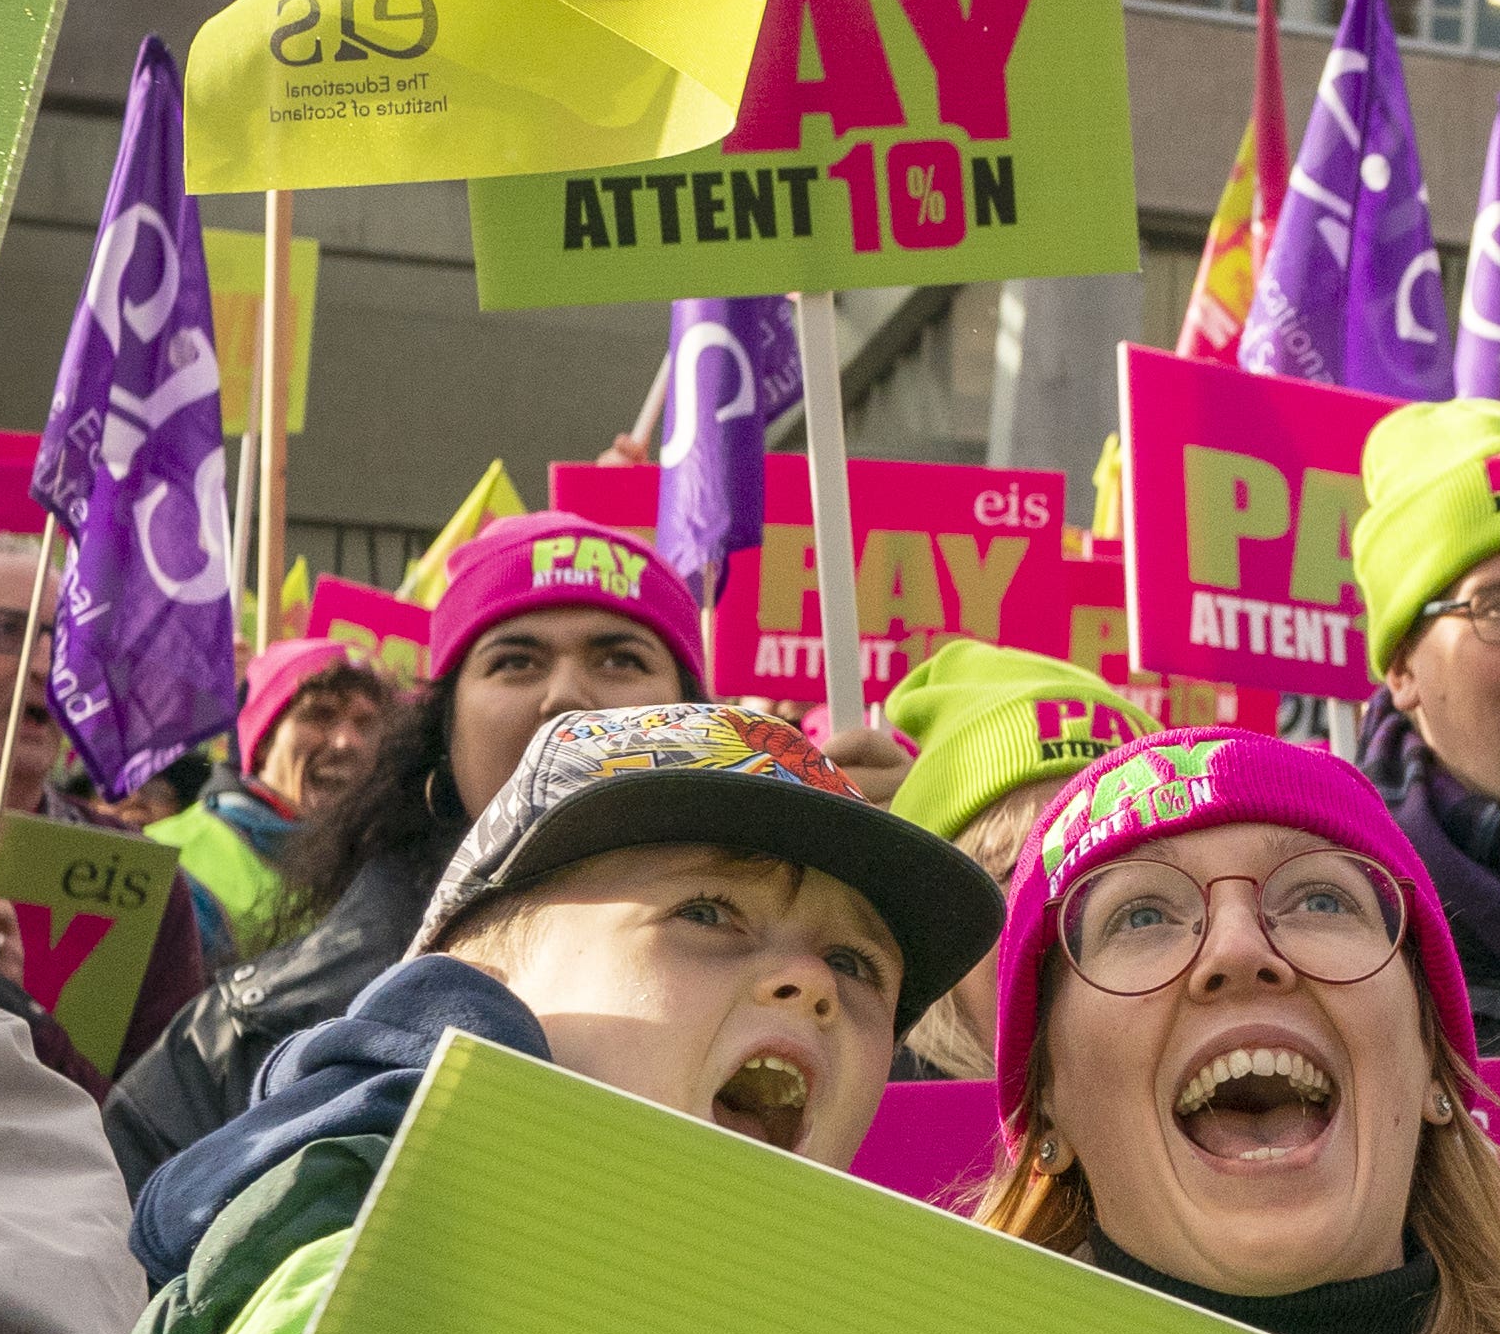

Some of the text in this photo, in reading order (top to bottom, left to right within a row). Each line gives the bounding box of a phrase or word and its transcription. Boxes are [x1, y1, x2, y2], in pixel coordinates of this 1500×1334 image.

[973, 482, 1050, 529] eis
[1185, 445, 1368, 605] PA
[532, 535, 648, 583] PAY
[1190, 592, 1356, 668] ATTENT
[1034, 698, 1137, 743] PA
[1041, 738, 1237, 879] PAY
[60, 853, 152, 911] eis
